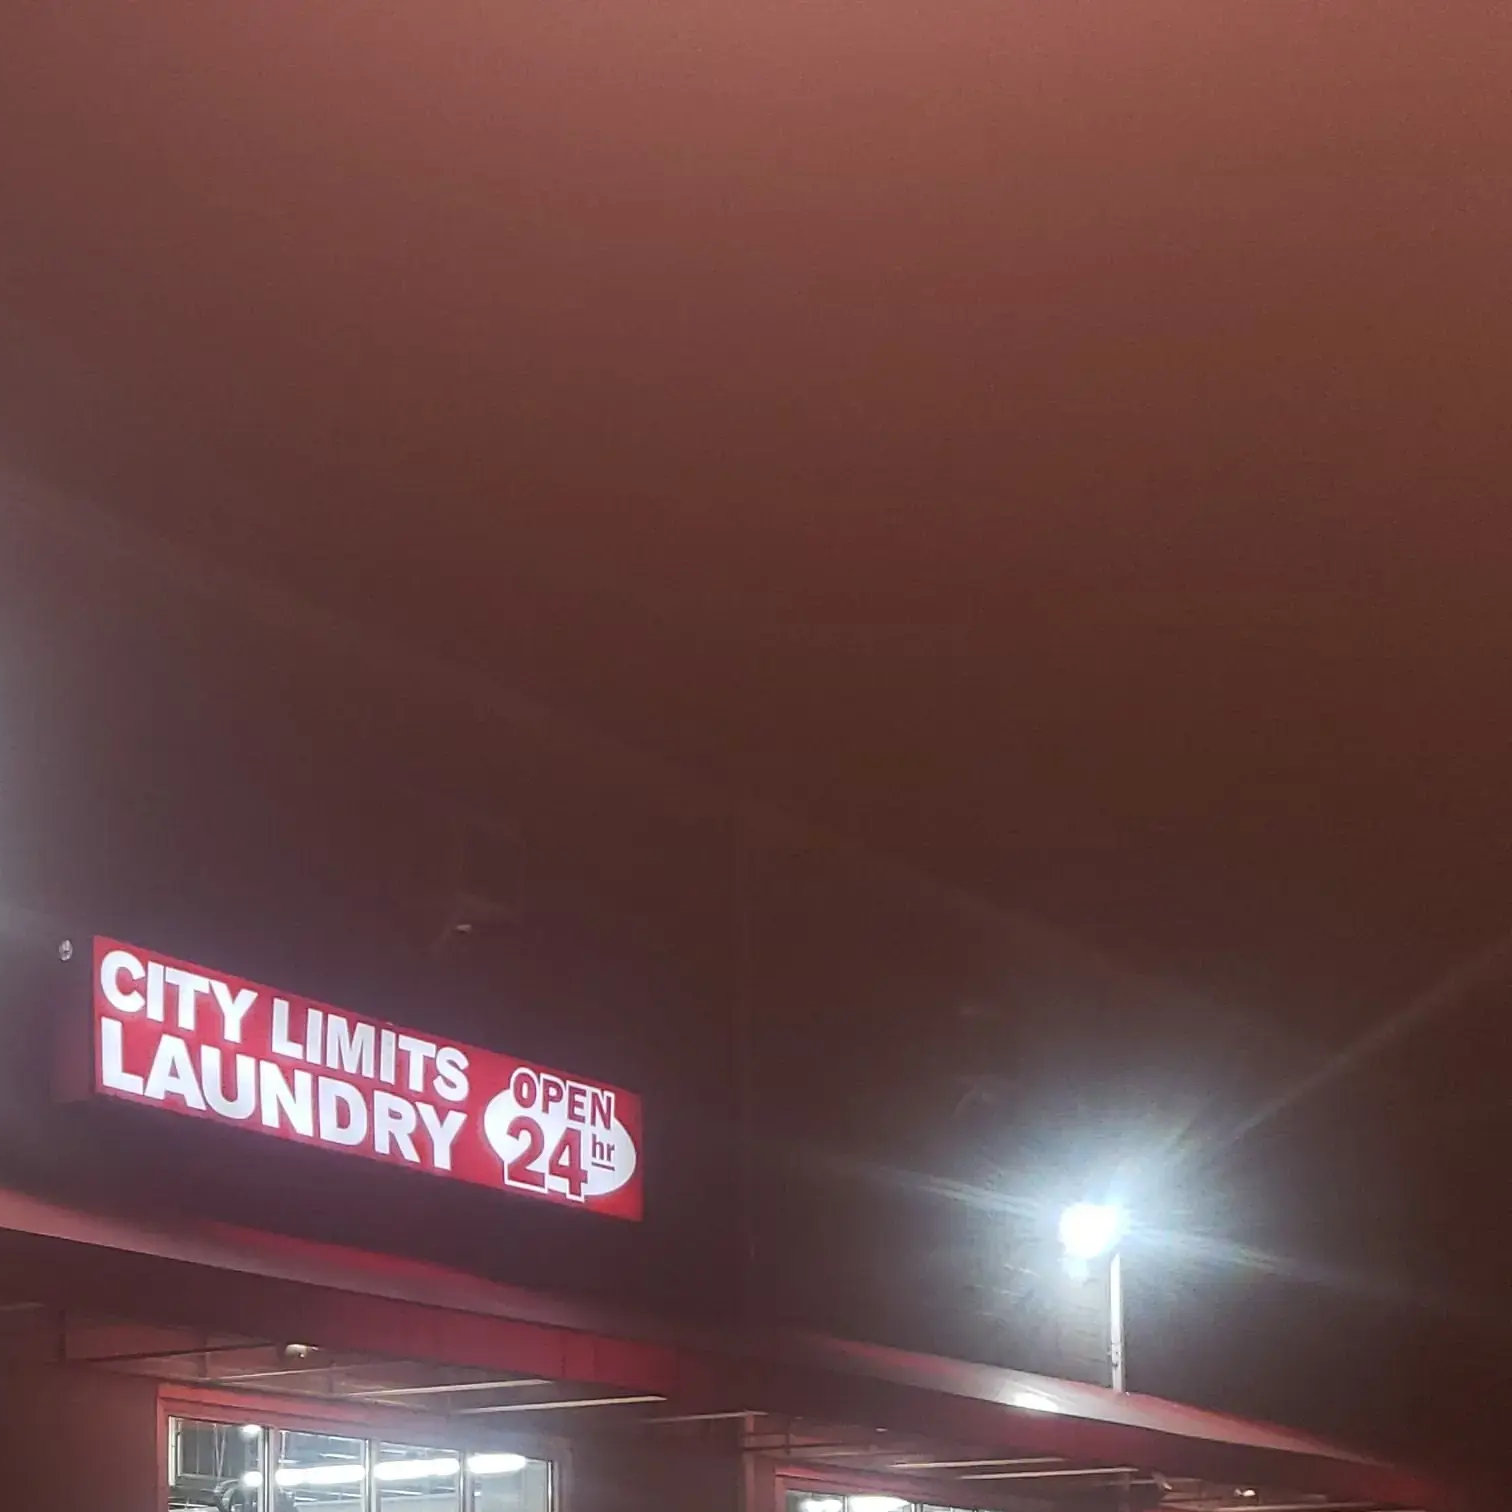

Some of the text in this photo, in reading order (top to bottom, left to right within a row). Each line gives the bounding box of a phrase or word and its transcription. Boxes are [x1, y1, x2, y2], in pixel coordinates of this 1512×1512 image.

[100, 950, 470, 1102] CITY LIMITS
[100, 1016, 468, 1171] LAUNDRY
[511, 1070, 614, 1131] OPEN
[505, 1114, 616, 1198] 24 hr
